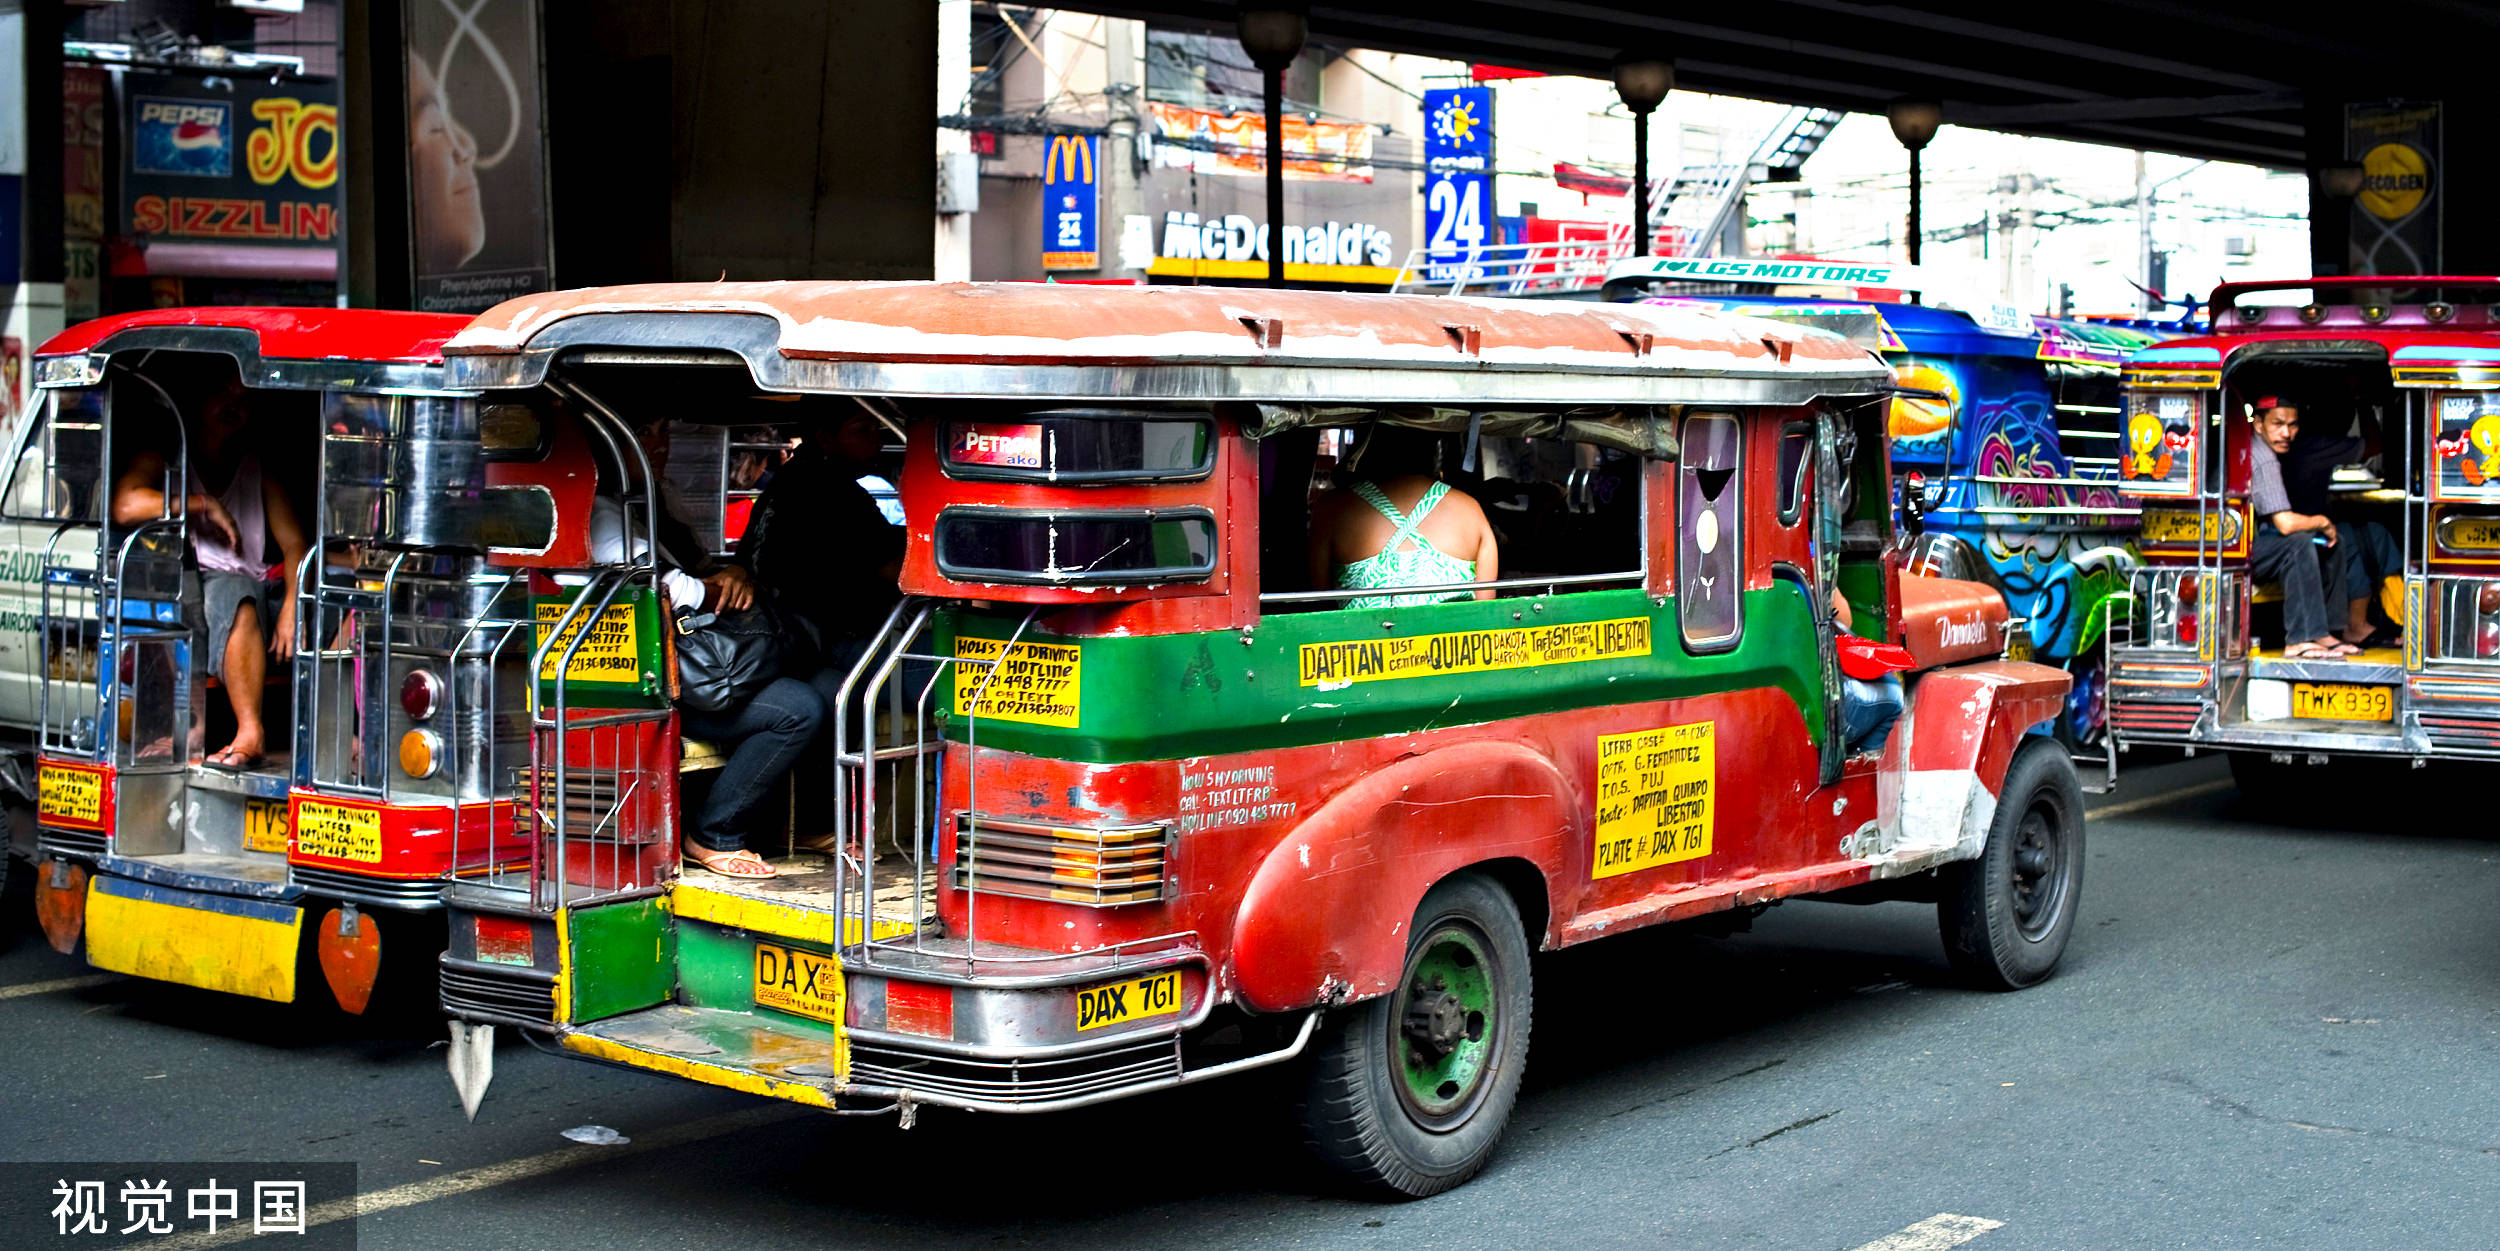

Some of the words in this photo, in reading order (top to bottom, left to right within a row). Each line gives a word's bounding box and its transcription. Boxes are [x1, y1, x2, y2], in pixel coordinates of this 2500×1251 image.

[142, 103, 225, 126] PEPSI
[133, 195, 338, 240] SIZZLIN
[1429, 180, 1485, 257] 24
[1058, 221, 1082, 238] 24
[1684, 261, 1751, 275] LGS
[1752, 264, 1891, 283] MOTORS
[1007, 455, 1038, 466] ako
[603, 634, 630, 644] 7777
[1595, 619, 1650, 655] LIBERTAD
[1303, 643, 1384, 680] DAPITAN
[1430, 633, 1492, 670] QUIAPO
[1036, 677, 1070, 690] 7777
[2297, 690, 2338, 711] TWK
[2345, 692, 2386, 712] 839
[1603, 739, 1632, 758] LTFRB
[1641, 770, 1664, 790] PUJ
[1673, 780, 1708, 801] QUIAPO
[1269, 802, 1297, 818] 7777
[1657, 799, 1705, 828] LIBERTAD
[1599, 838, 1633, 869] PLATE
[1651, 829, 1677, 858] DAX
[760, 950, 820, 998] DAX
[1080, 985, 1127, 1027] DAX
